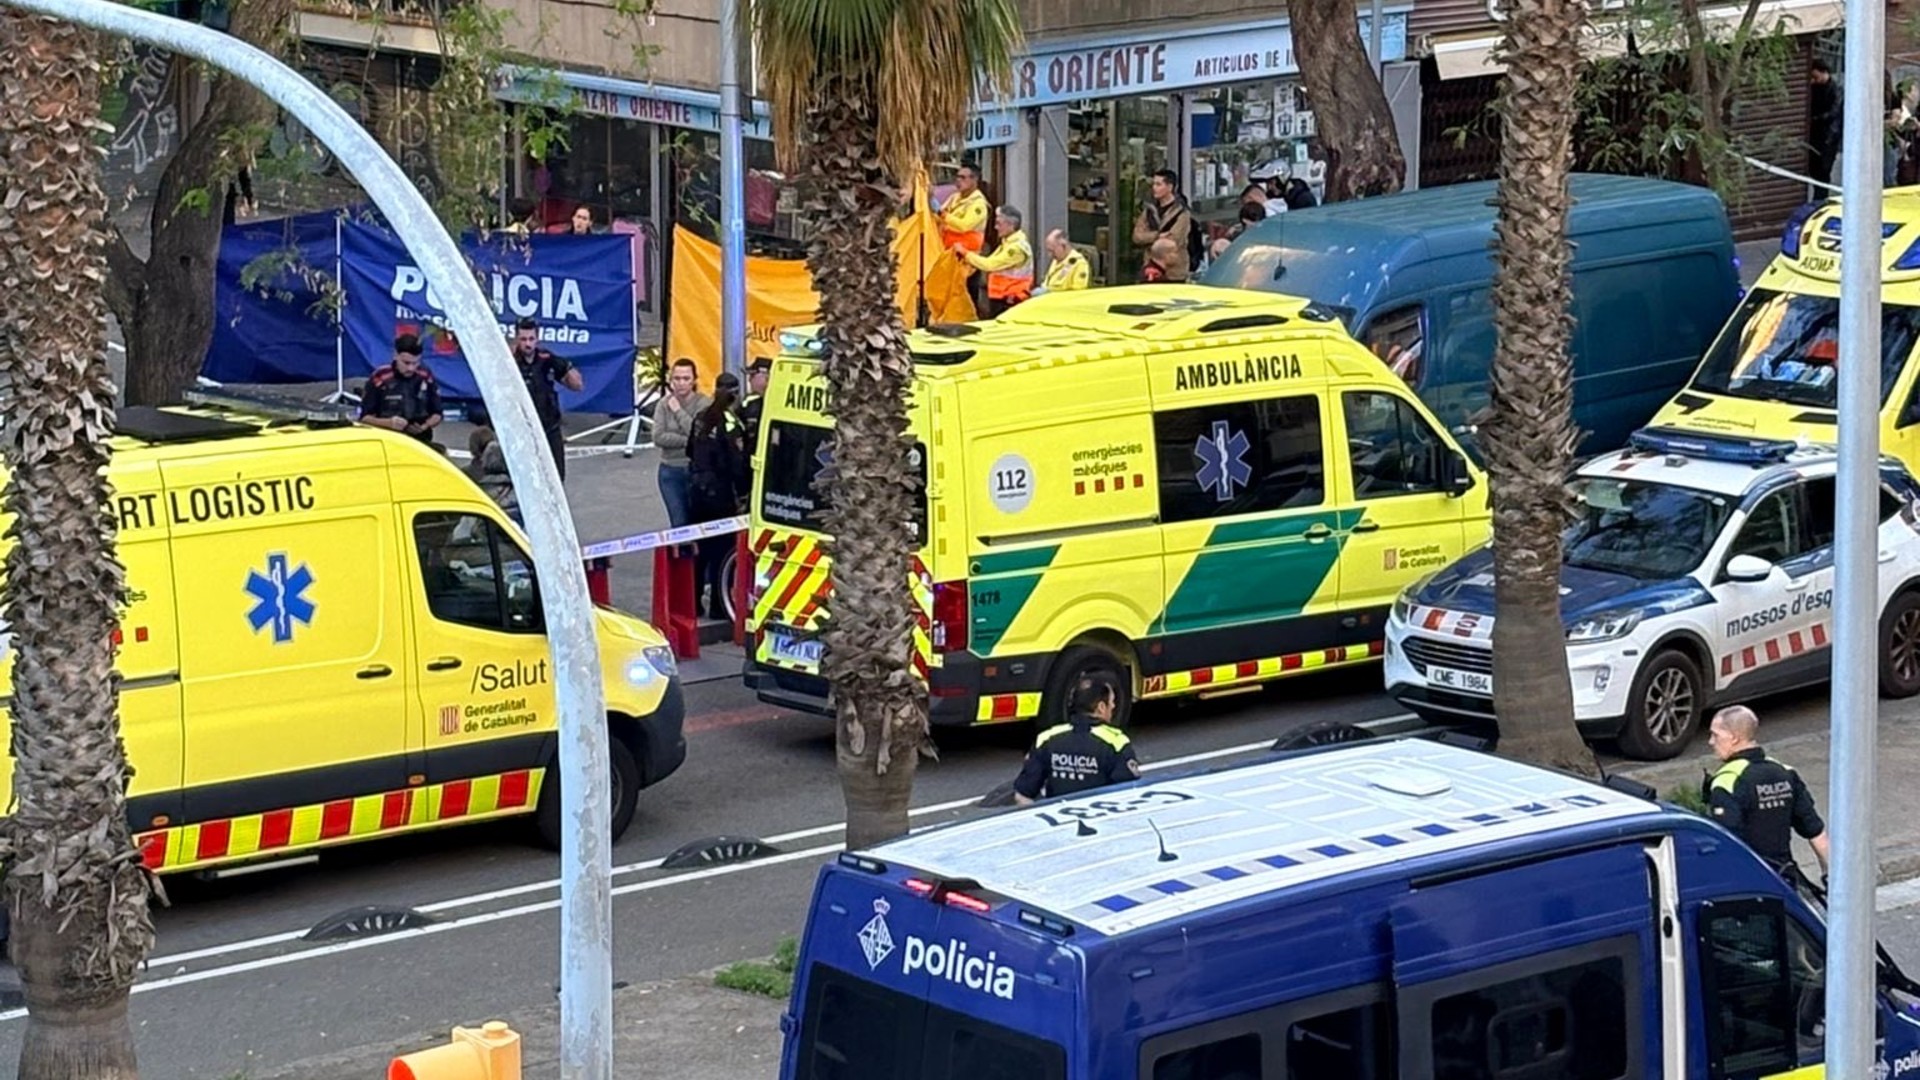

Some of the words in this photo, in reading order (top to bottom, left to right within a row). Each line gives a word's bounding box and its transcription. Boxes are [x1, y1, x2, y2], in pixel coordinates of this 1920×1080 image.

[1049, 44, 1166, 95] ORIENTE
[1194, 52, 1260, 78] ARTICULOS
[1265, 50, 1280, 72] DE
[581, 88, 619, 114] AZAR
[629, 96, 691, 123] ORIENTE
[391, 265, 588, 322] PICIA
[1175, 352, 1302, 391] AMBULÀNCIA
[996, 468, 1027, 491] 112
[170, 471, 315, 524] LOGÍSTIC
[1726, 604, 1787, 638] mossos
[464, 698, 527, 718] Generalitat
[464, 719, 479, 733] de
[481, 712, 537, 730] Catalunya
[1051, 752, 1099, 769] POLICIA
[1755, 780, 1794, 796] POLICIA
[903, 935, 1016, 1000] policia
[1894, 1048, 1920, 1078] poli
